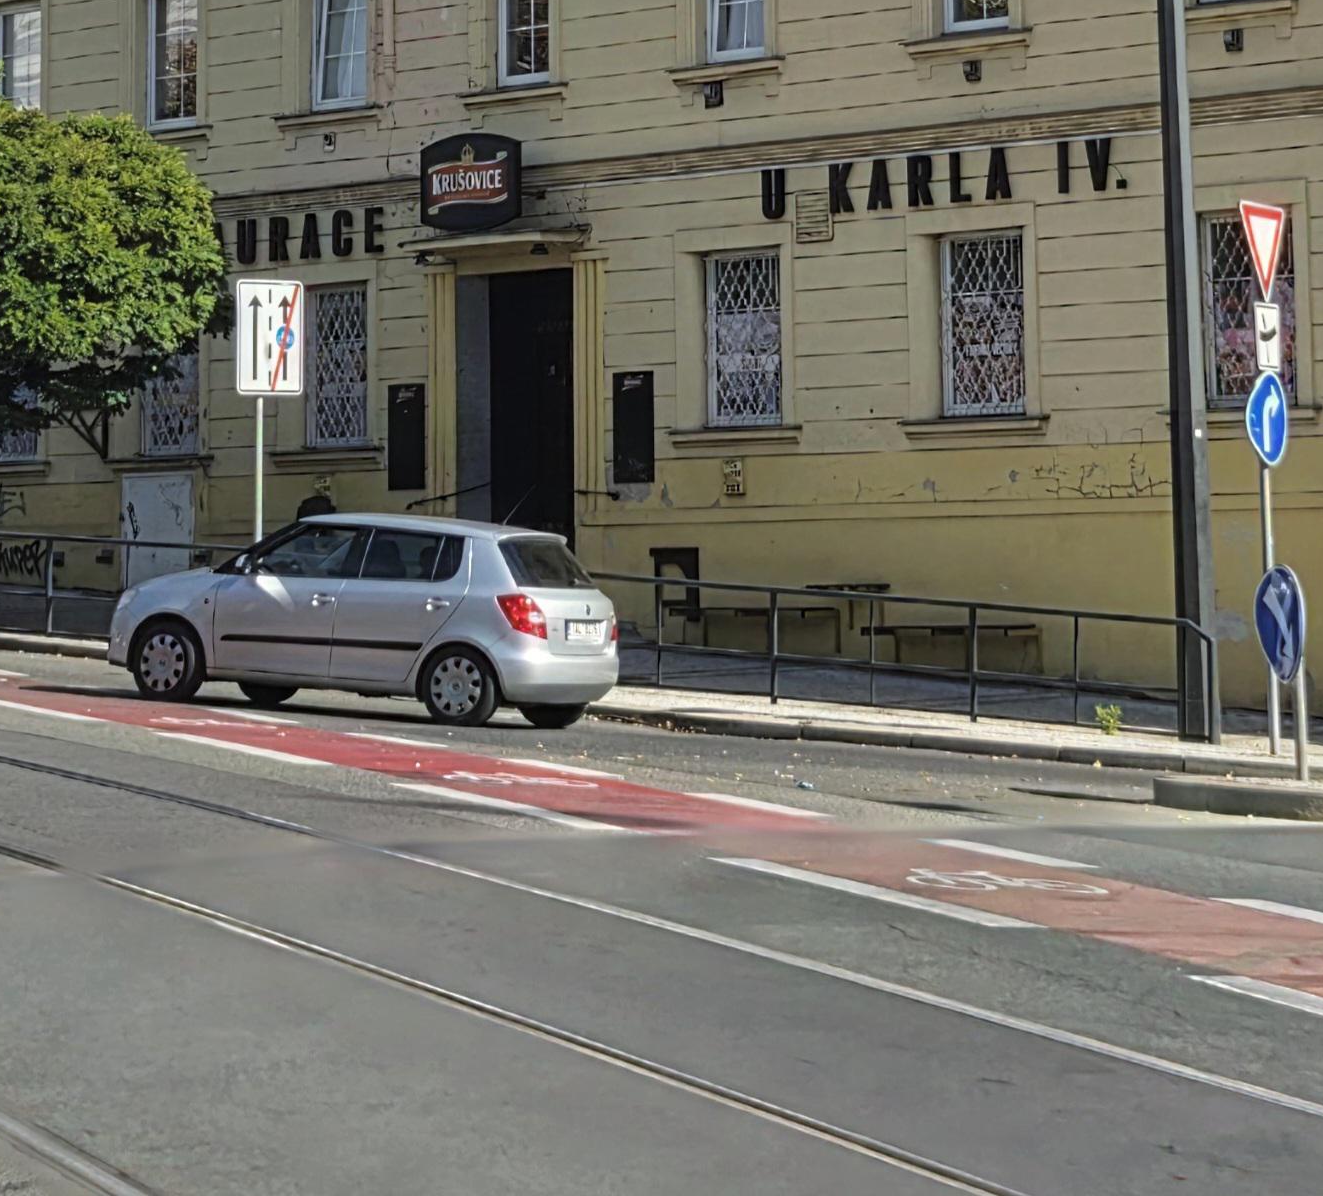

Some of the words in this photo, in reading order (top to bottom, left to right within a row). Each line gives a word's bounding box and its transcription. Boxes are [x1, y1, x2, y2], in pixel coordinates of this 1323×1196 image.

[432, 169, 503, 196] KRUŠOVICE
[761, 168, 786, 220] U
[828, 146, 1013, 214] KARLA
[1056, 136, 1127, 193] IV.
